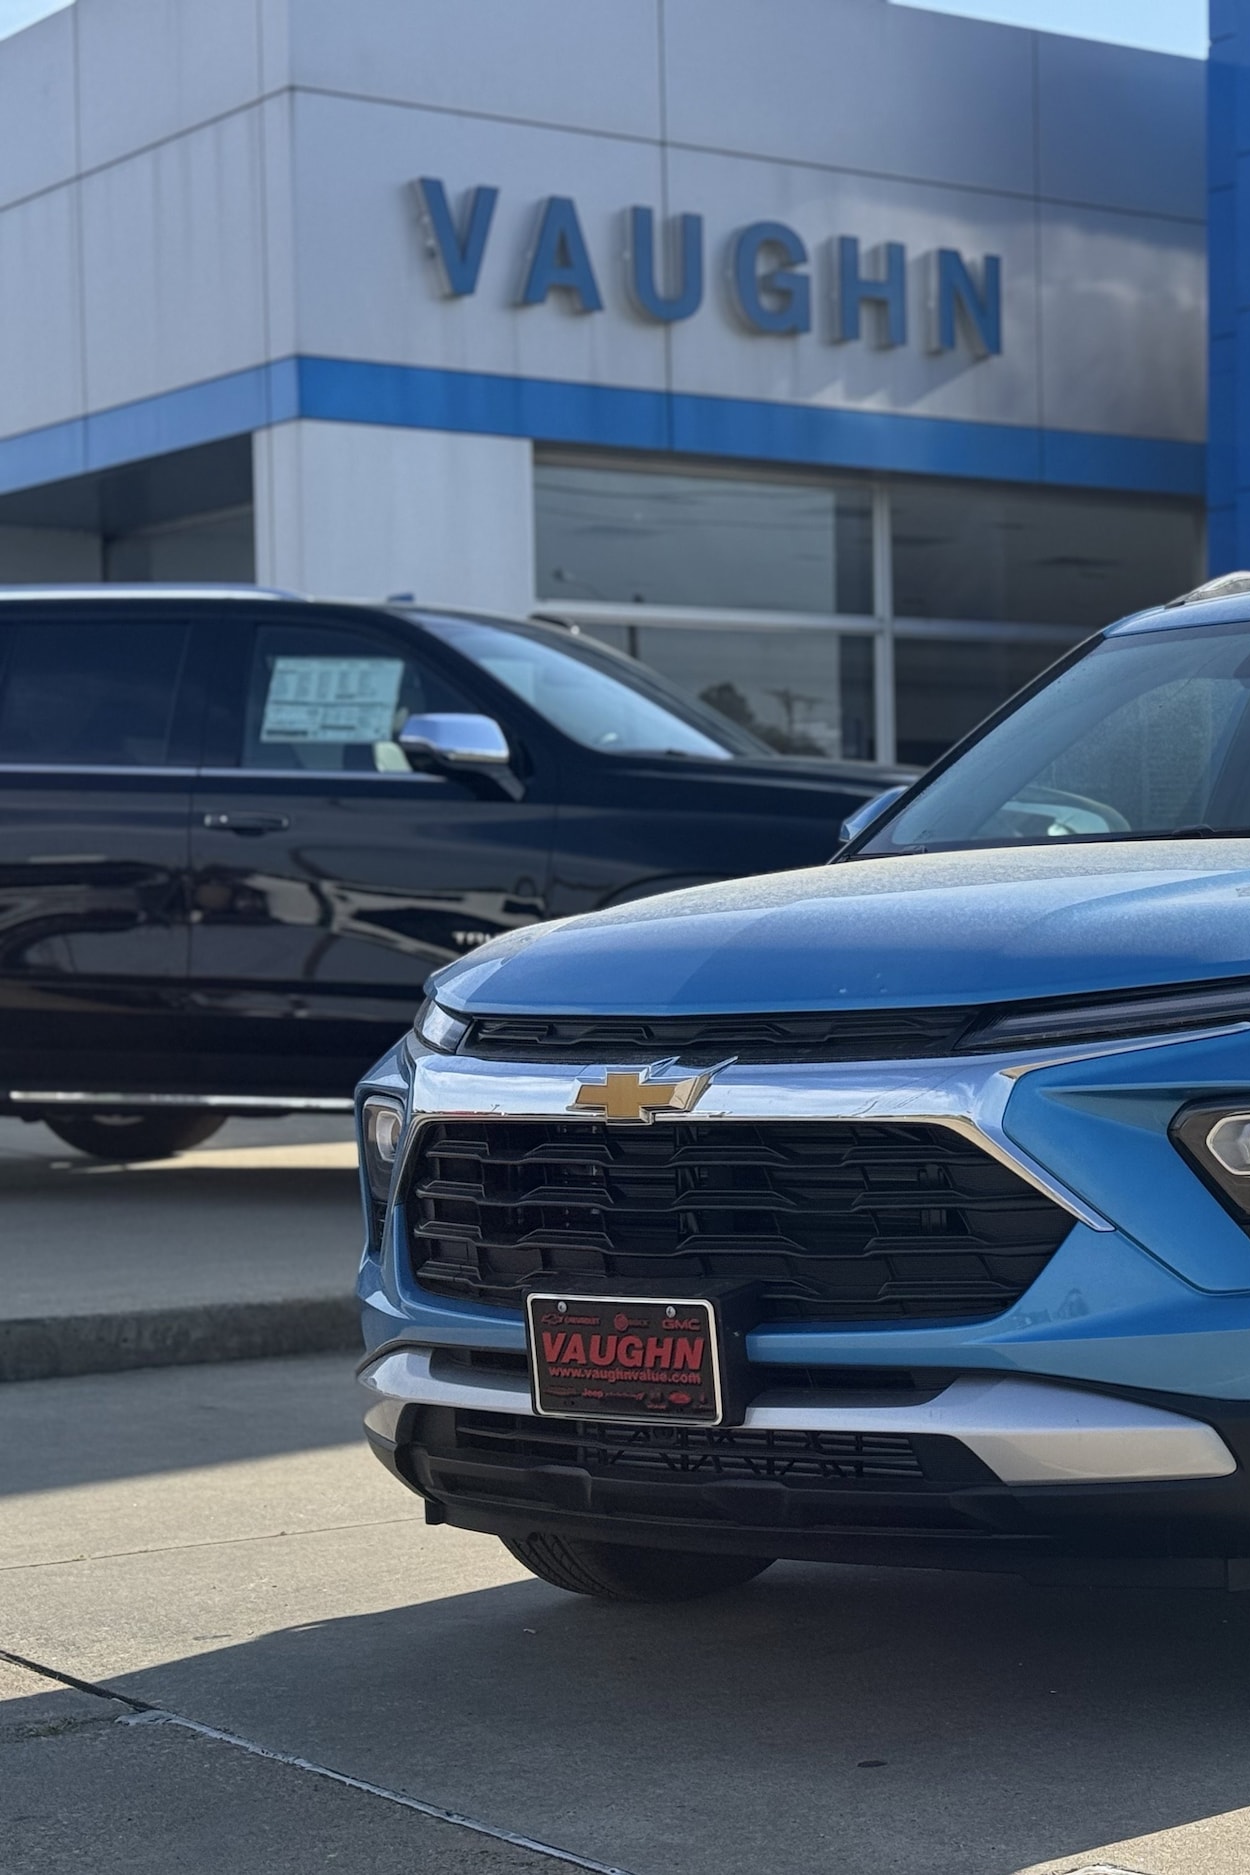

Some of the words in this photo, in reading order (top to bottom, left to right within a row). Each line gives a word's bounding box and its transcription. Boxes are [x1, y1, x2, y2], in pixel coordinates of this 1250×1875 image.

[412, 175, 1002, 358] VAUGHN
[662, 1318, 701, 1331] GMC
[541, 1331, 705, 1370] VAUGHN
[549, 1367, 702, 1385] www.vaughnvalue.com
